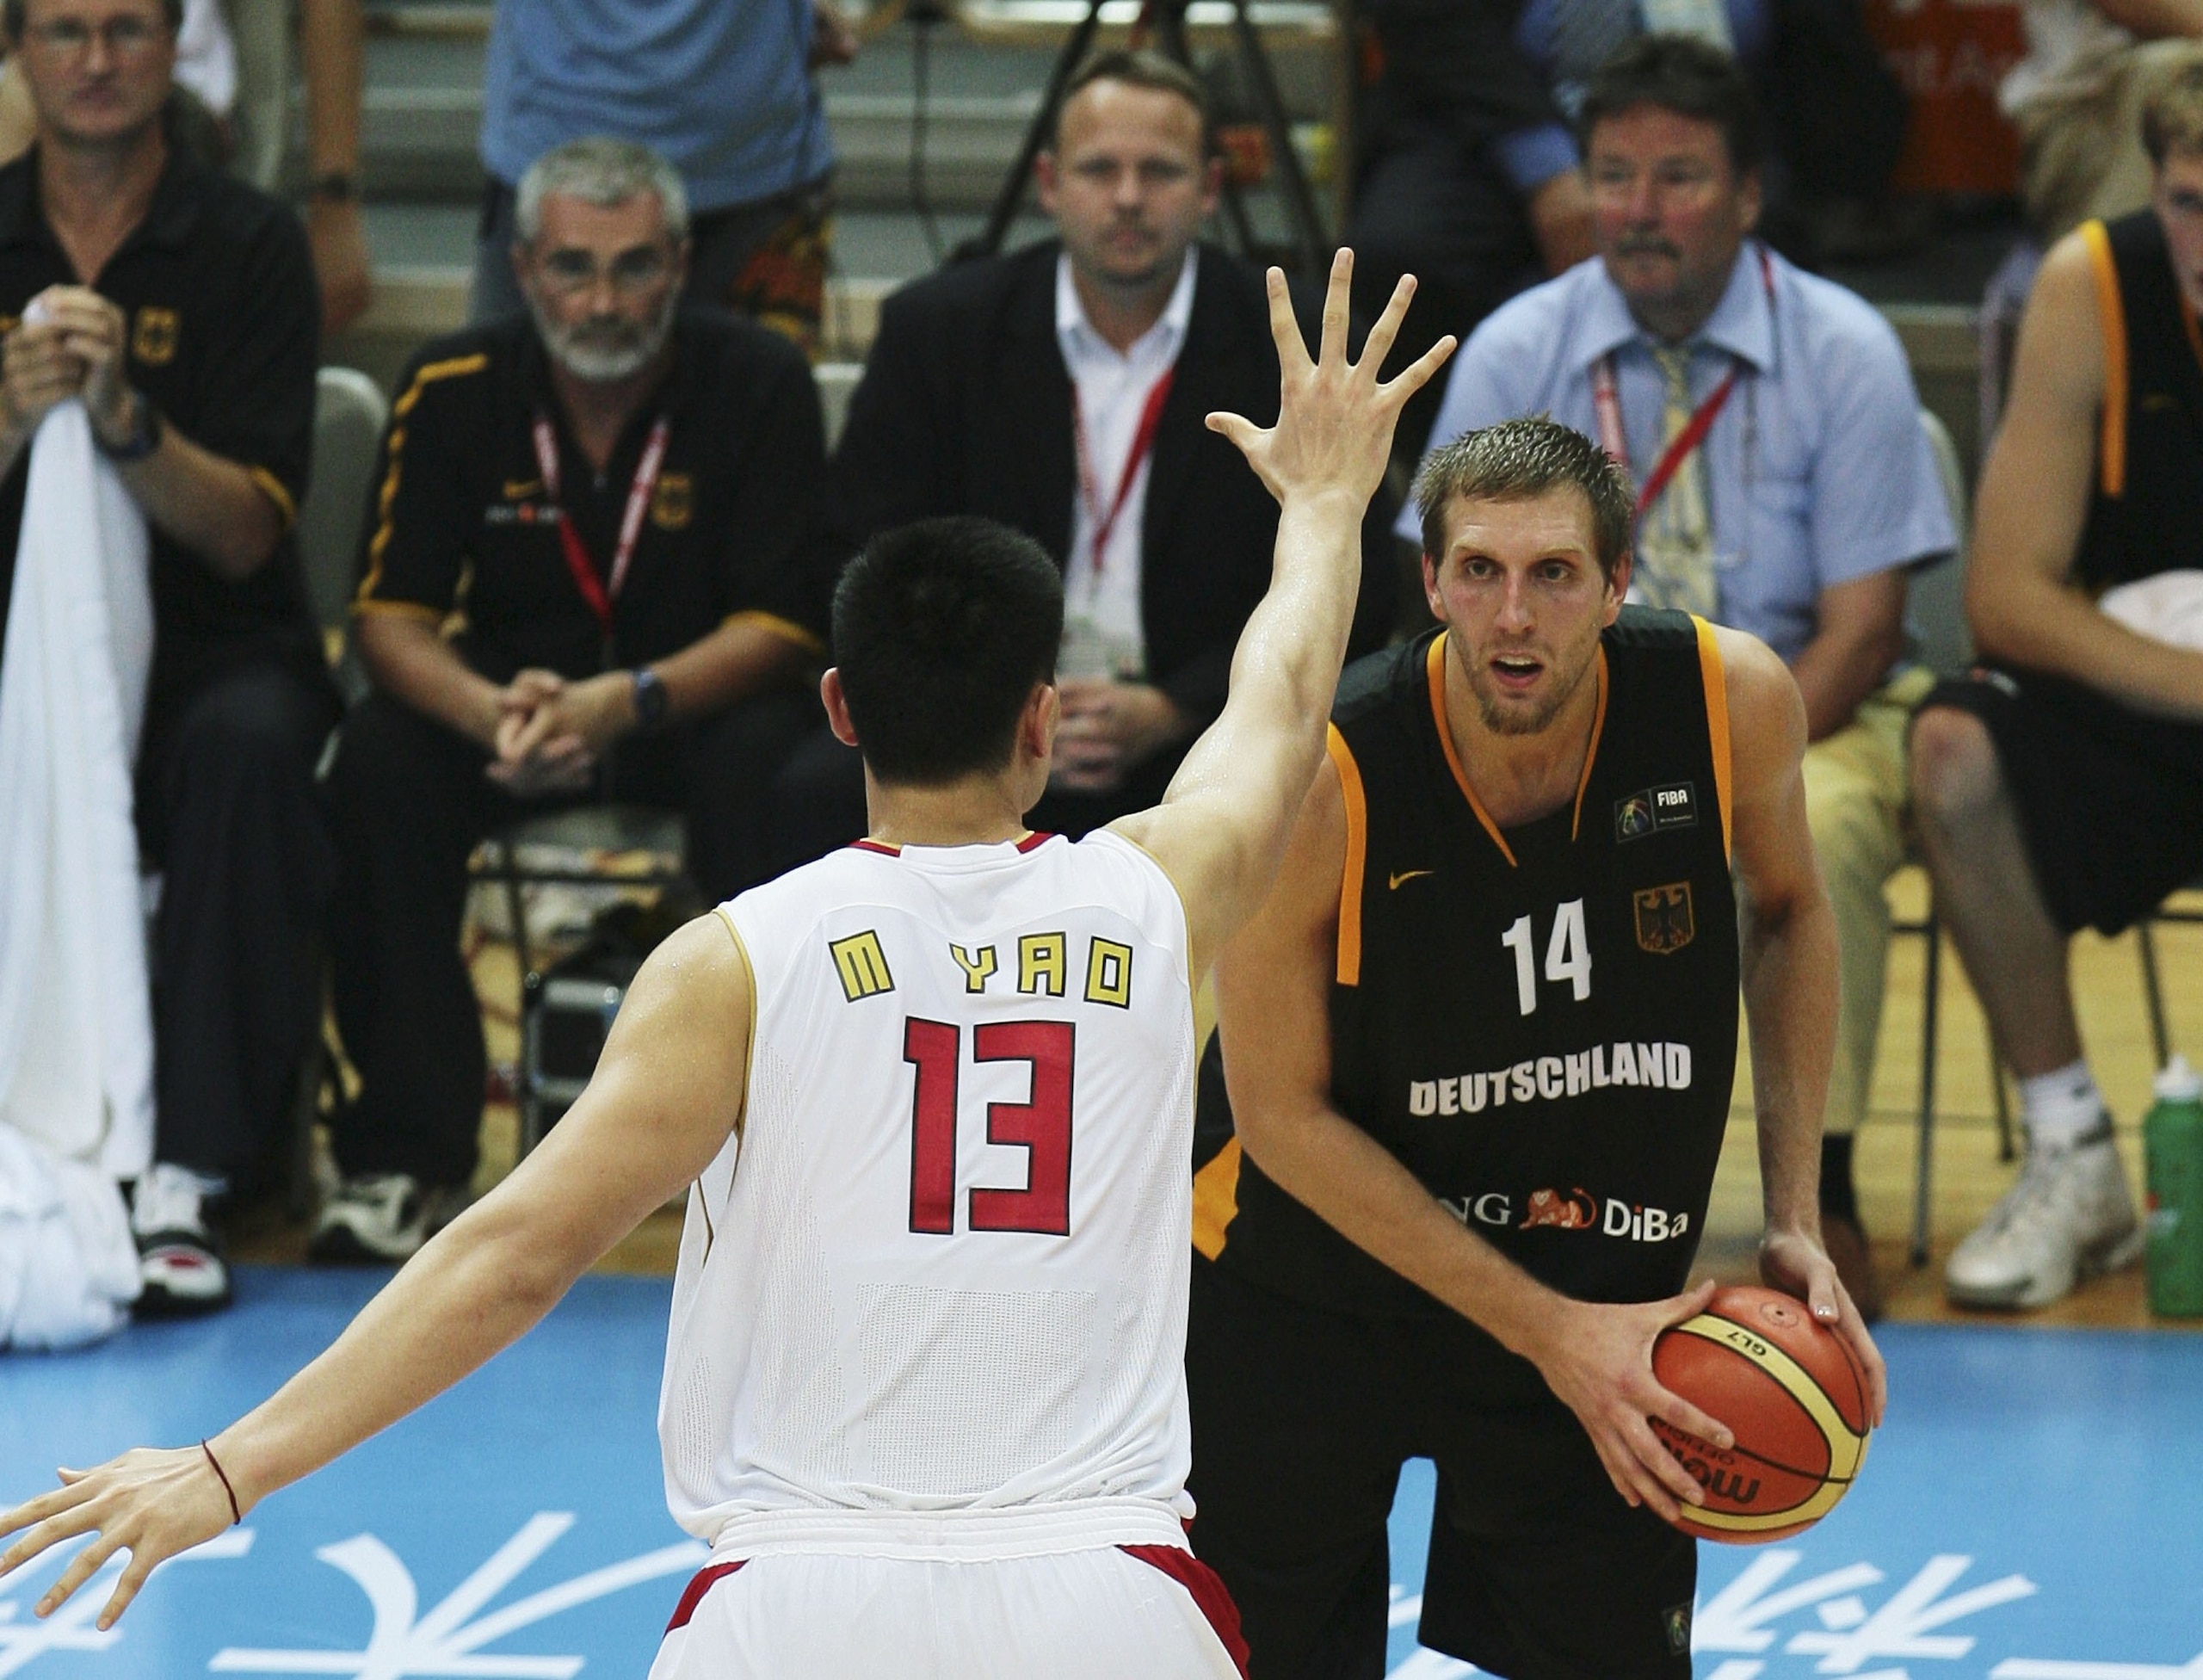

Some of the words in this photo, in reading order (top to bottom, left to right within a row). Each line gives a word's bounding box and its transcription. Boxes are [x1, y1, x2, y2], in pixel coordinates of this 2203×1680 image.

[1657, 789, 1688, 806] FIBA
[949, 931, 1133, 1010] YAO
[1502, 898, 1592, 1016] 14
[1409, 1041, 1692, 1116] DEUTSCHLAND
[904, 1016, 1076, 1237] 13
[1437, 1192, 1512, 1226] NG
[1602, 1197, 1688, 1242] DiBa
[1726, 1331, 1767, 1356] GL7
